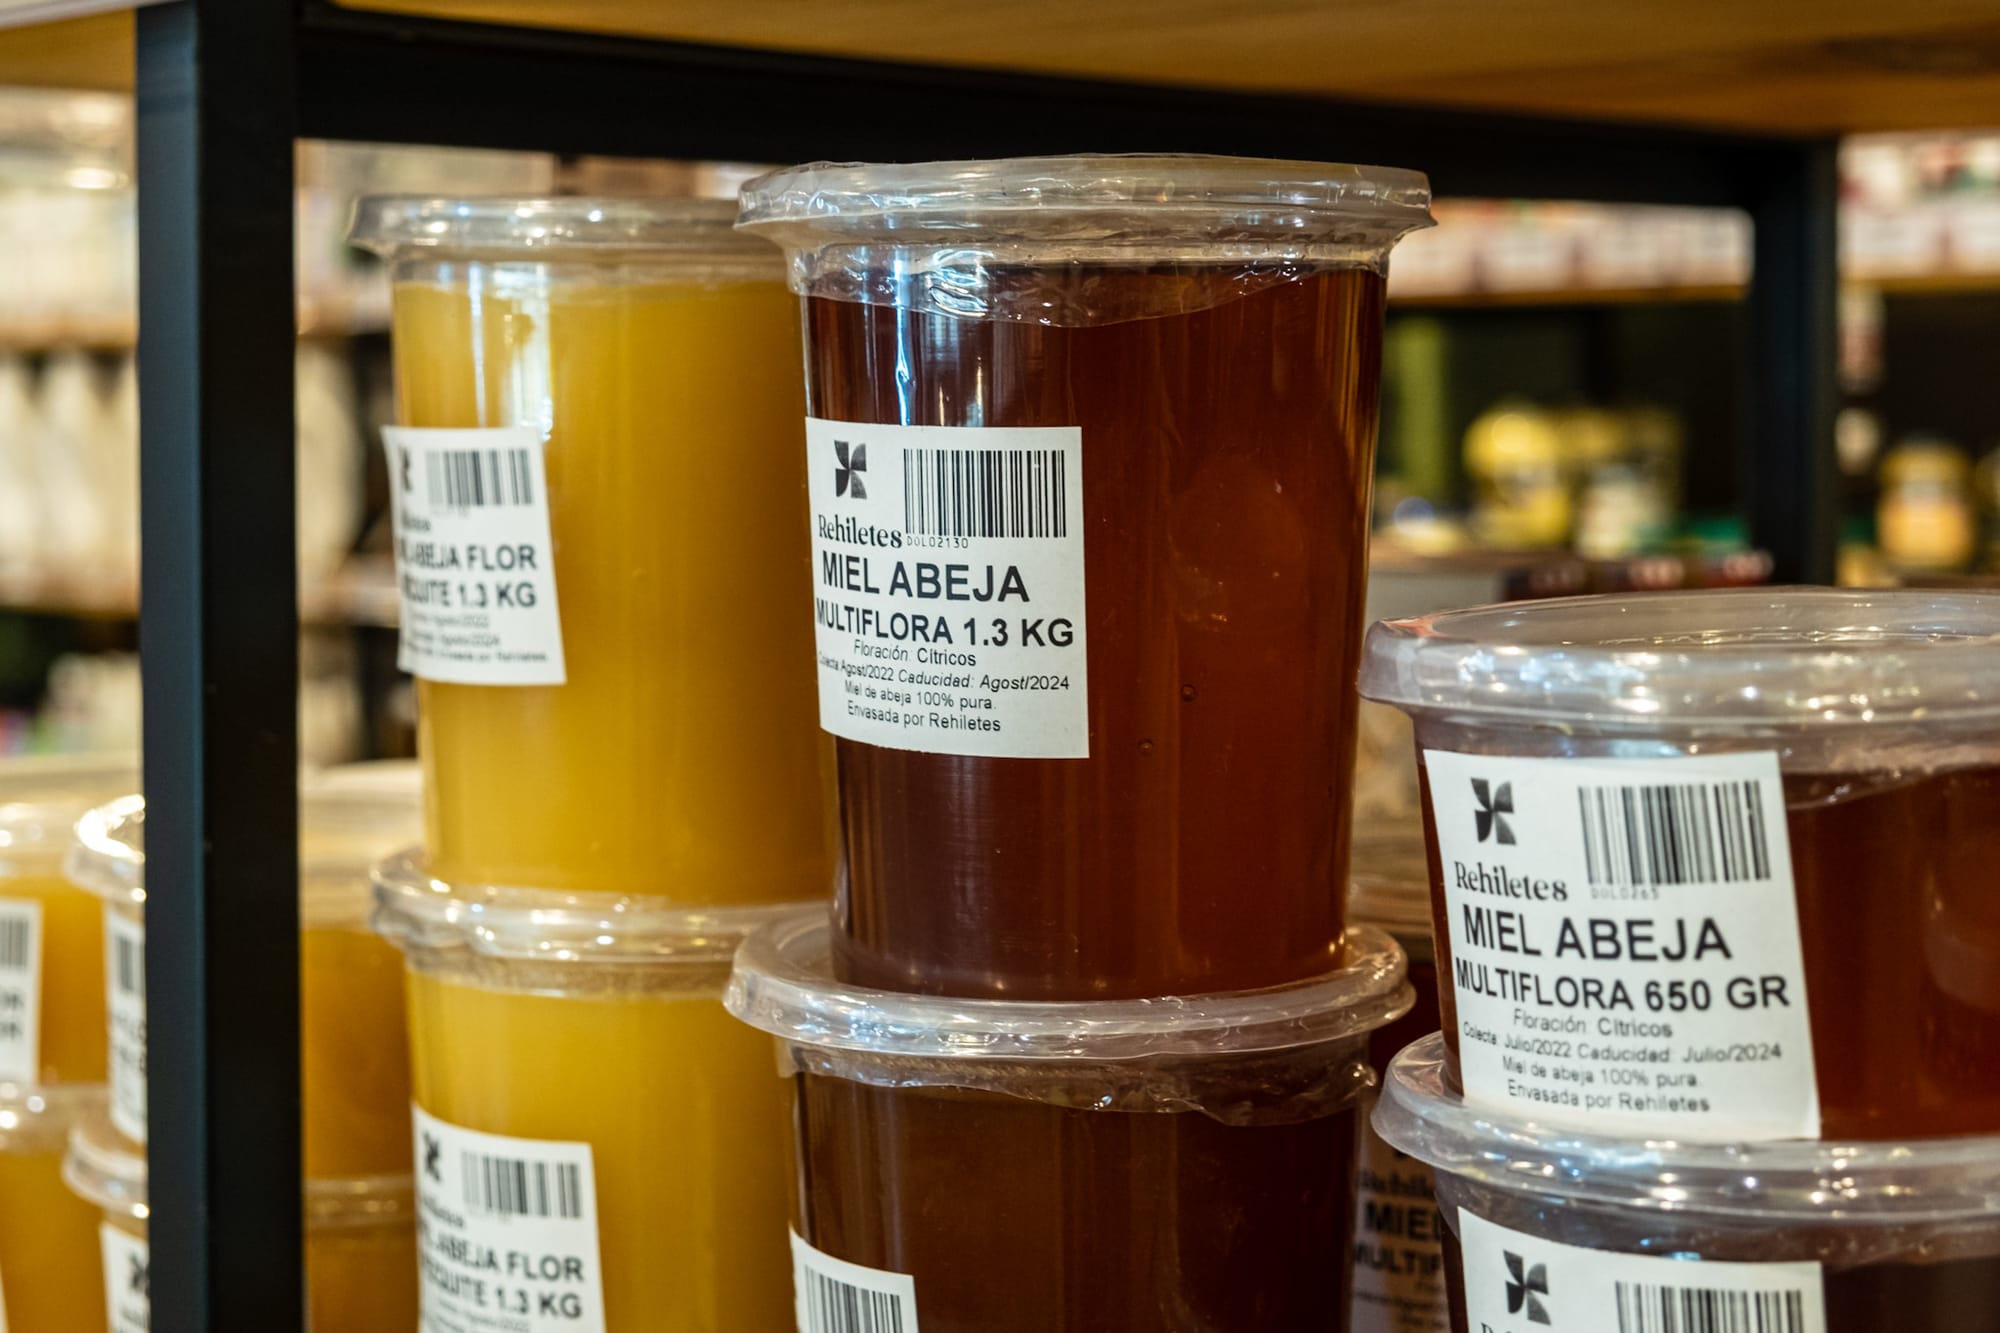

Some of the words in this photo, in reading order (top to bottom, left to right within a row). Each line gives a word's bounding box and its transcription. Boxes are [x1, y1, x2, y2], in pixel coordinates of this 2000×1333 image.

[818, 514, 902, 549] Rehiletes
[466, 544, 538, 570] FLOR
[823, 550, 880, 595] MIEL
[889, 561, 1030, 603] ABEJA
[496, 581, 537, 608] KG
[816, 597, 953, 645] MULTIFLORA
[962, 618, 1009, 647] 1.3
[1021, 618, 1073, 647] KG
[841, 660, 894, 681] Agost/2022
[979, 674, 1070, 692] Agost/2024
[845, 680, 862, 696] Miel
[865, 687, 876, 699] de
[880, 688, 911, 706] abeja
[917, 692, 954, 708] 100%
[847, 700, 899, 724] Envasada
[903, 714, 925, 728] por
[929, 712, 1001, 732] Rehiletes
[1454, 861, 1569, 902] Rehiletes
[1463, 903, 1542, 957] MIEL
[1556, 917, 1733, 961] ABEJA
[1455, 957, 1634, 1011] MULTIFLORA
[1646, 981, 1711, 1012] 650
[1726, 975, 1791, 1009] GR
[1504, 1033, 1572, 1058] Julio/2022
[1682, 1043, 1782, 1063] Julio/2024
[1502, 1056, 1527, 1074] Miel
[1531, 1062, 1547, 1078] de
[1552, 1065, 1594, 1085] abeja
[1601, 1069, 1649, 1086] 100%
[1508, 1079, 1579, 1107] Envasada
[1586, 1094, 1612, 1110] por
[1618, 1093, 1710, 1112] Rehiletes
[506, 1251, 584, 1282] FLOR
[539, 1292, 582, 1318] KG
